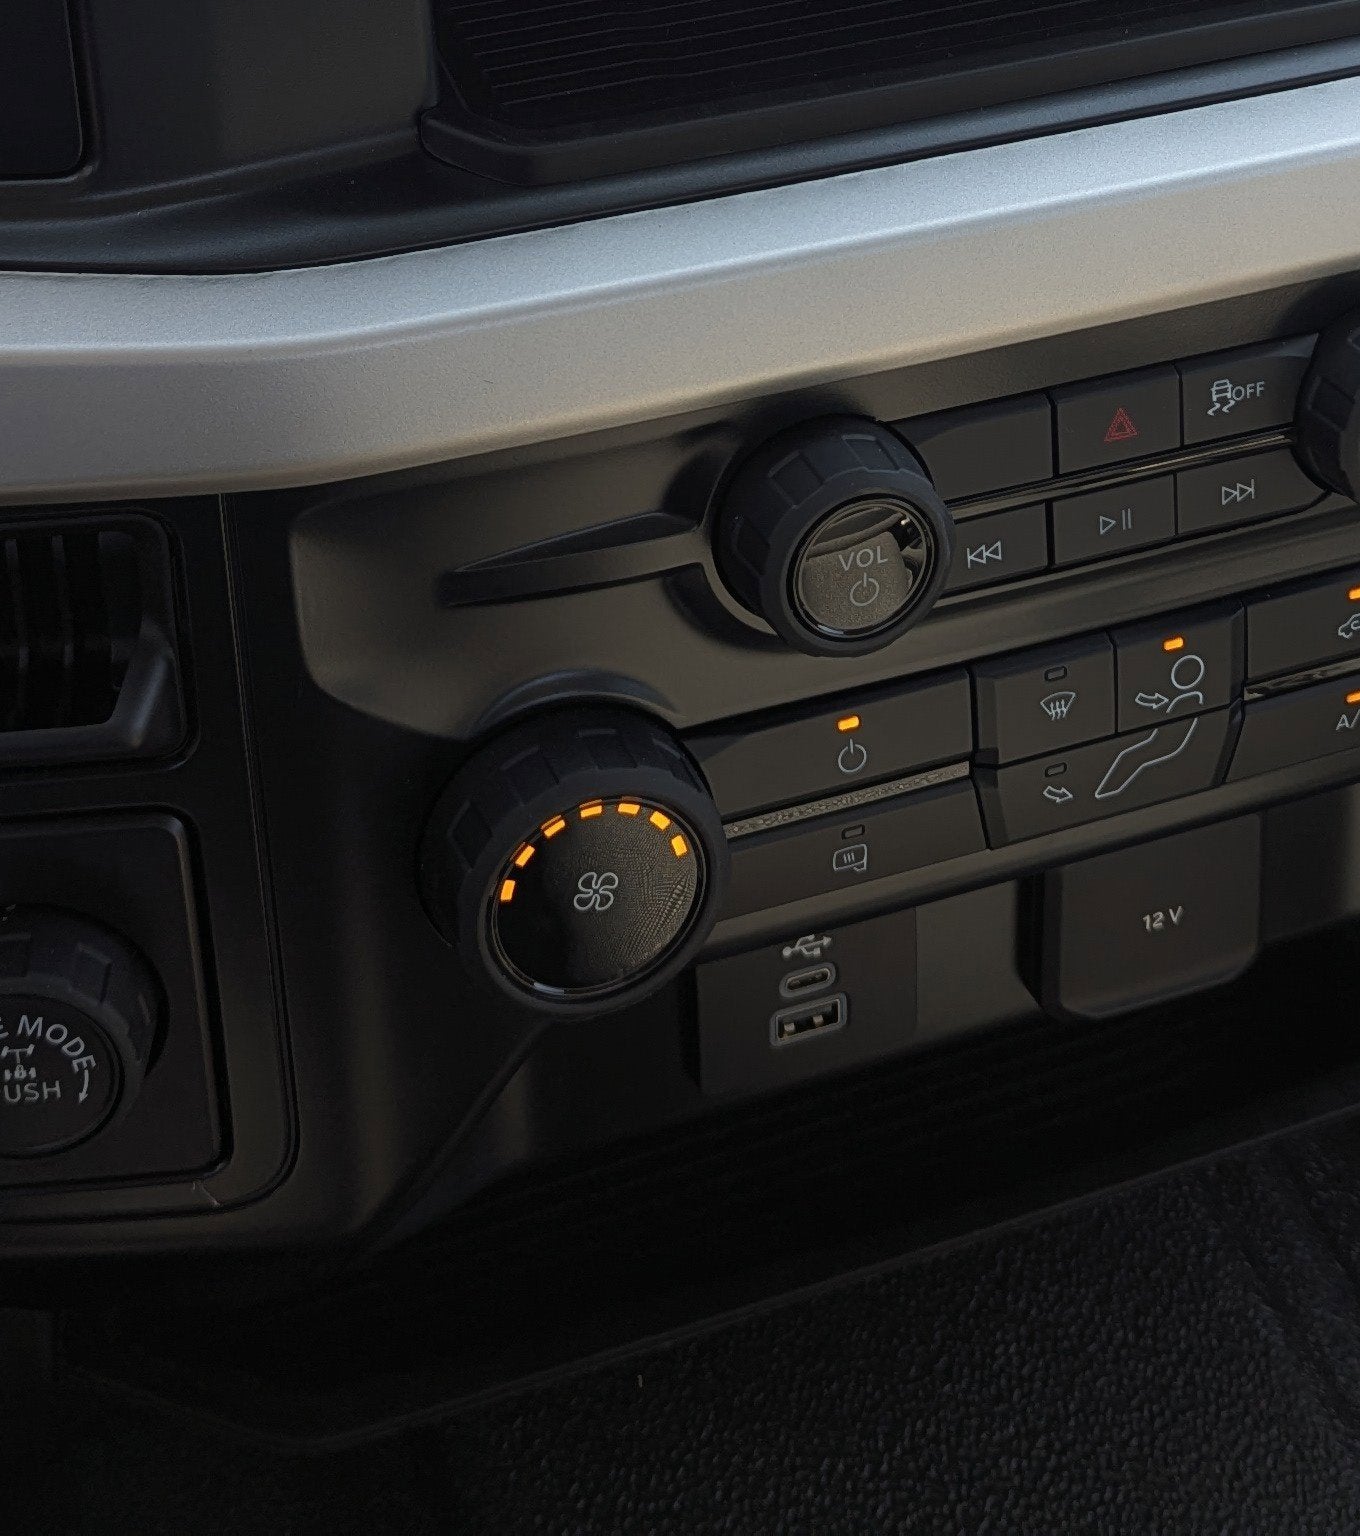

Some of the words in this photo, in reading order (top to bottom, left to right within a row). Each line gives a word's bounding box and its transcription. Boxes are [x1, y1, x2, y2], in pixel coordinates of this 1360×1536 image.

[1232, 379, 1266, 402] OFF
[839, 545, 888, 572] VOL
[1142, 910, 1165, 932] 12
[1168, 905, 1184, 926] V
[17, 1014, 97, 1072] MODE
